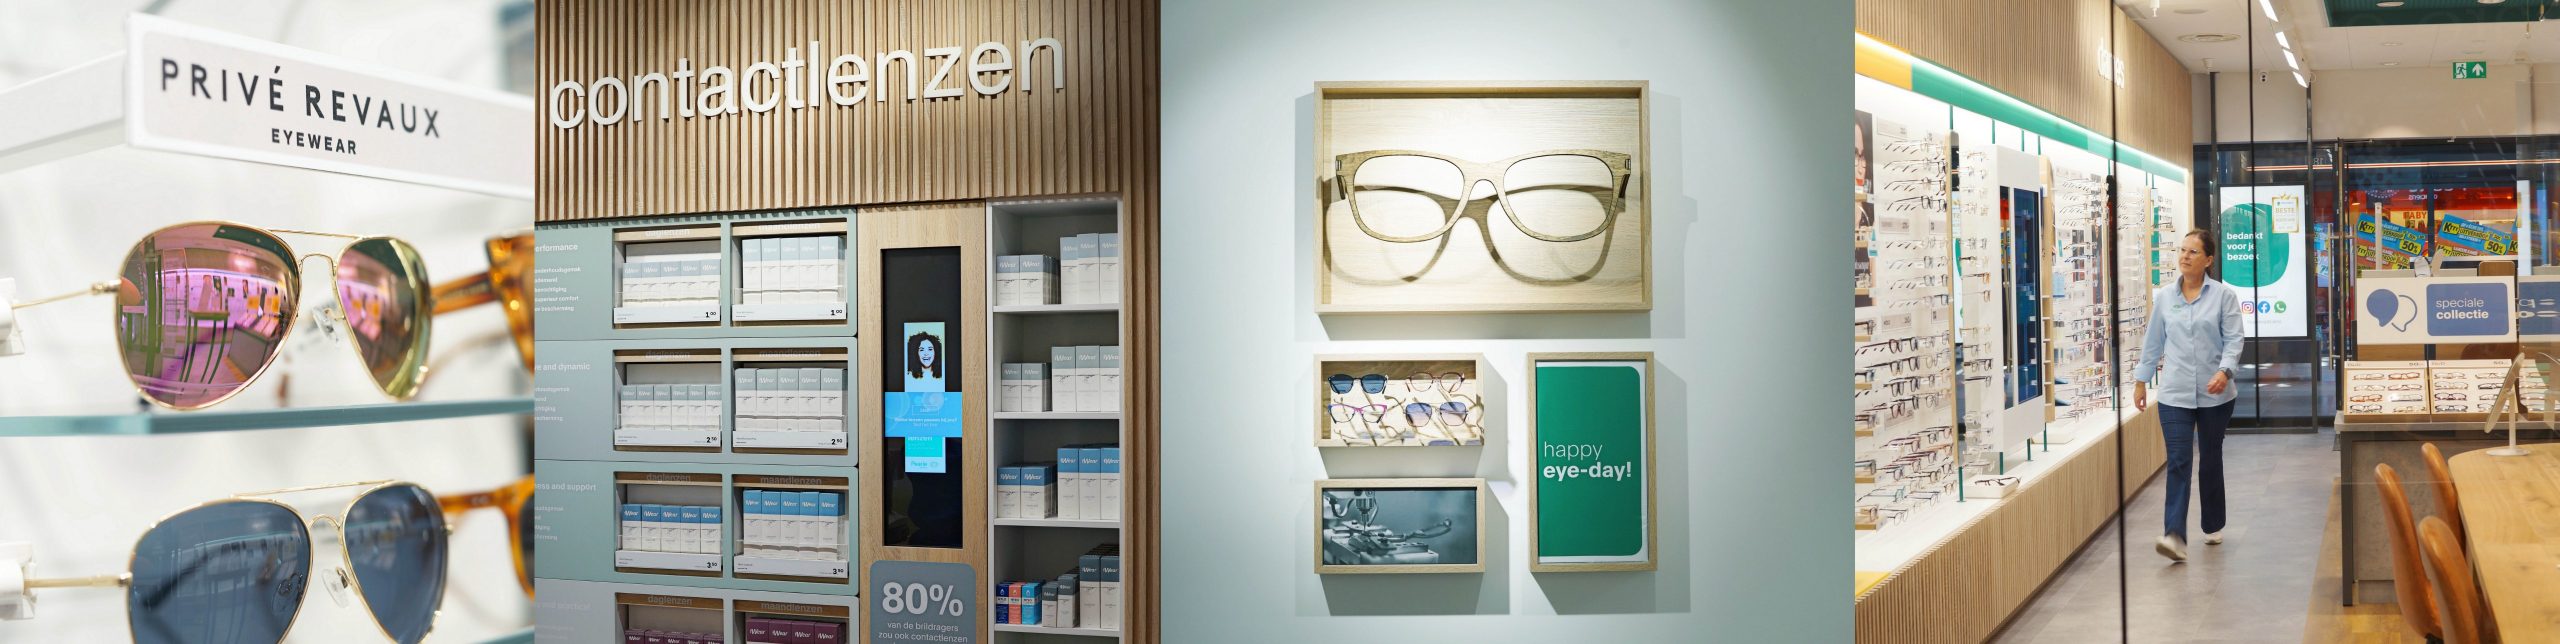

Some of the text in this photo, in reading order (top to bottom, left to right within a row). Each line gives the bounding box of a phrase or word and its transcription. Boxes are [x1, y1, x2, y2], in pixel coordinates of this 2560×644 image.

[549, 36, 1064, 130] contactlenzen
[162, 58, 439, 138] PRIVÉ REVAUX
[271, 128, 356, 155] EYEWEAR
[2226, 232, 2263, 240] bedankt
[2436, 297, 2484, 309] speciale
[2436, 309, 2489, 320] collectie
[543, 363, 557, 371] and
[1544, 441, 1603, 461] happy
[1543, 462, 1632, 481] eye-day!
[567, 484, 597, 492] support
[647, 595, 693, 606] daglenzen
[882, 581, 964, 617] 80%
[761, 602, 823, 614] maandlenzen
[903, 622, 914, 630] de
[915, 622, 959, 633] brildragers
[878, 632, 968, 643] zou ook contactlenzen
